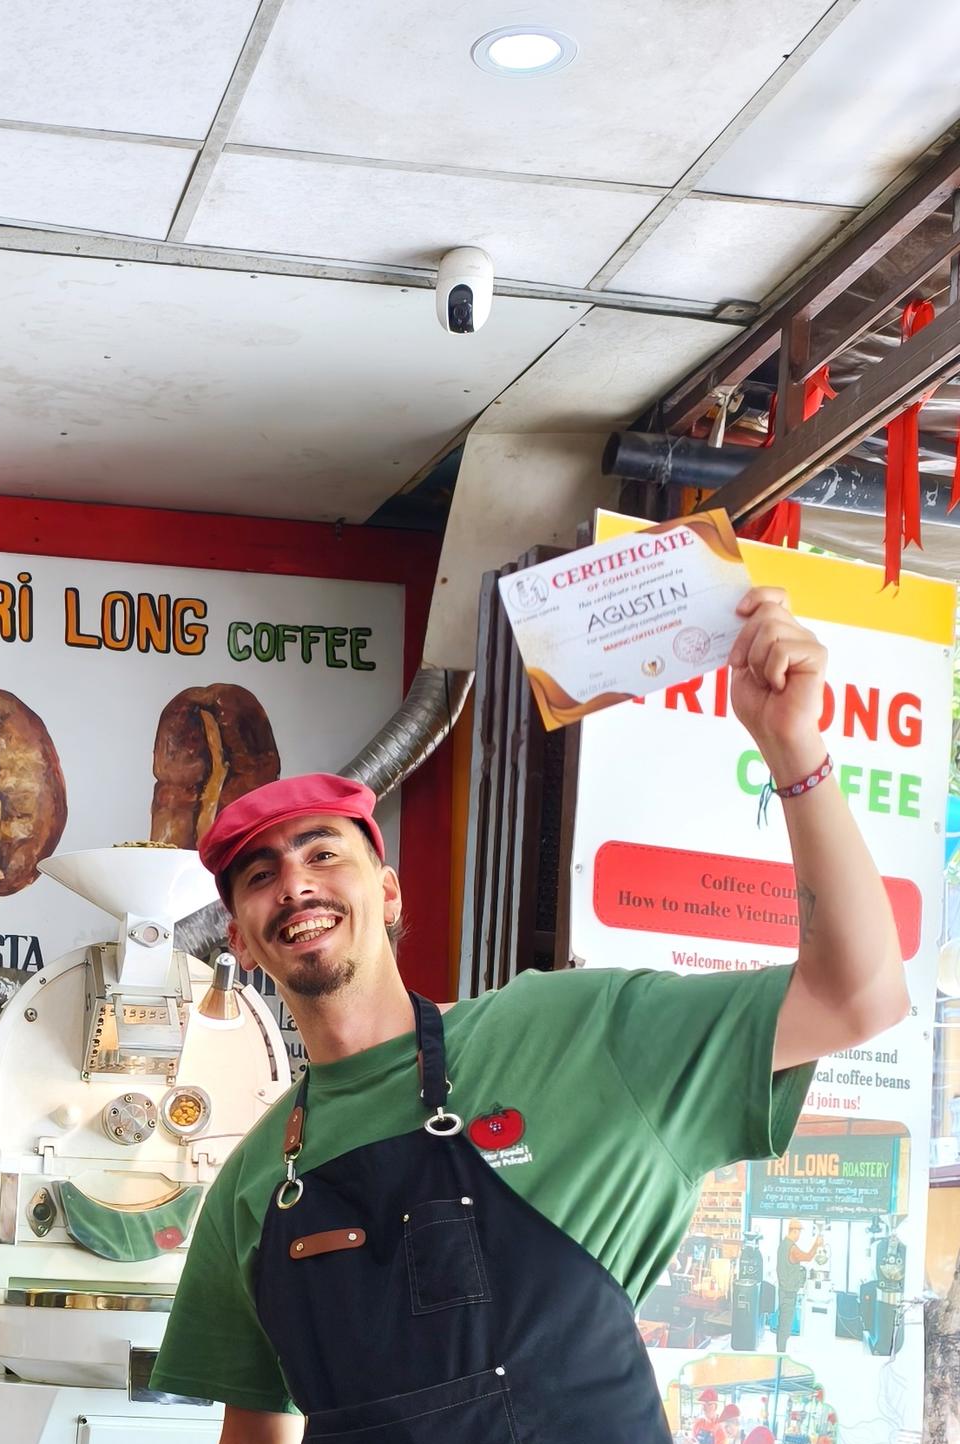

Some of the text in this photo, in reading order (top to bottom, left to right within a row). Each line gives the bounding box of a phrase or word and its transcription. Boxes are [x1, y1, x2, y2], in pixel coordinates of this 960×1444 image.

[551, 531, 694, 589] CERTIFICATE
[586, 559, 665, 592] OF COMPLETION
[587, 582, 688, 632] AGUSTIN
[64, 586, 209, 656] LONG
[227, 620, 376, 671] COFFEE
[737, 750, 922, 818] CFEE
[701, 873, 798, 899] Coffee Cour
[618, 890, 655, 909] How
[662, 896, 678, 912] to
[684, 901, 730, 918] make
[671, 950, 732, 970] Welcome
[735, 958, 748, 971] to
[875, 1049, 898, 1064] and
[814, 1068, 911, 1090] cal coffee beans
[816, 1092, 840, 1110] join
[843, 1096, 861, 1110] us!
[793, 1153, 840, 1177] LONG
[842, 1161, 890, 1178] ROASTERY
